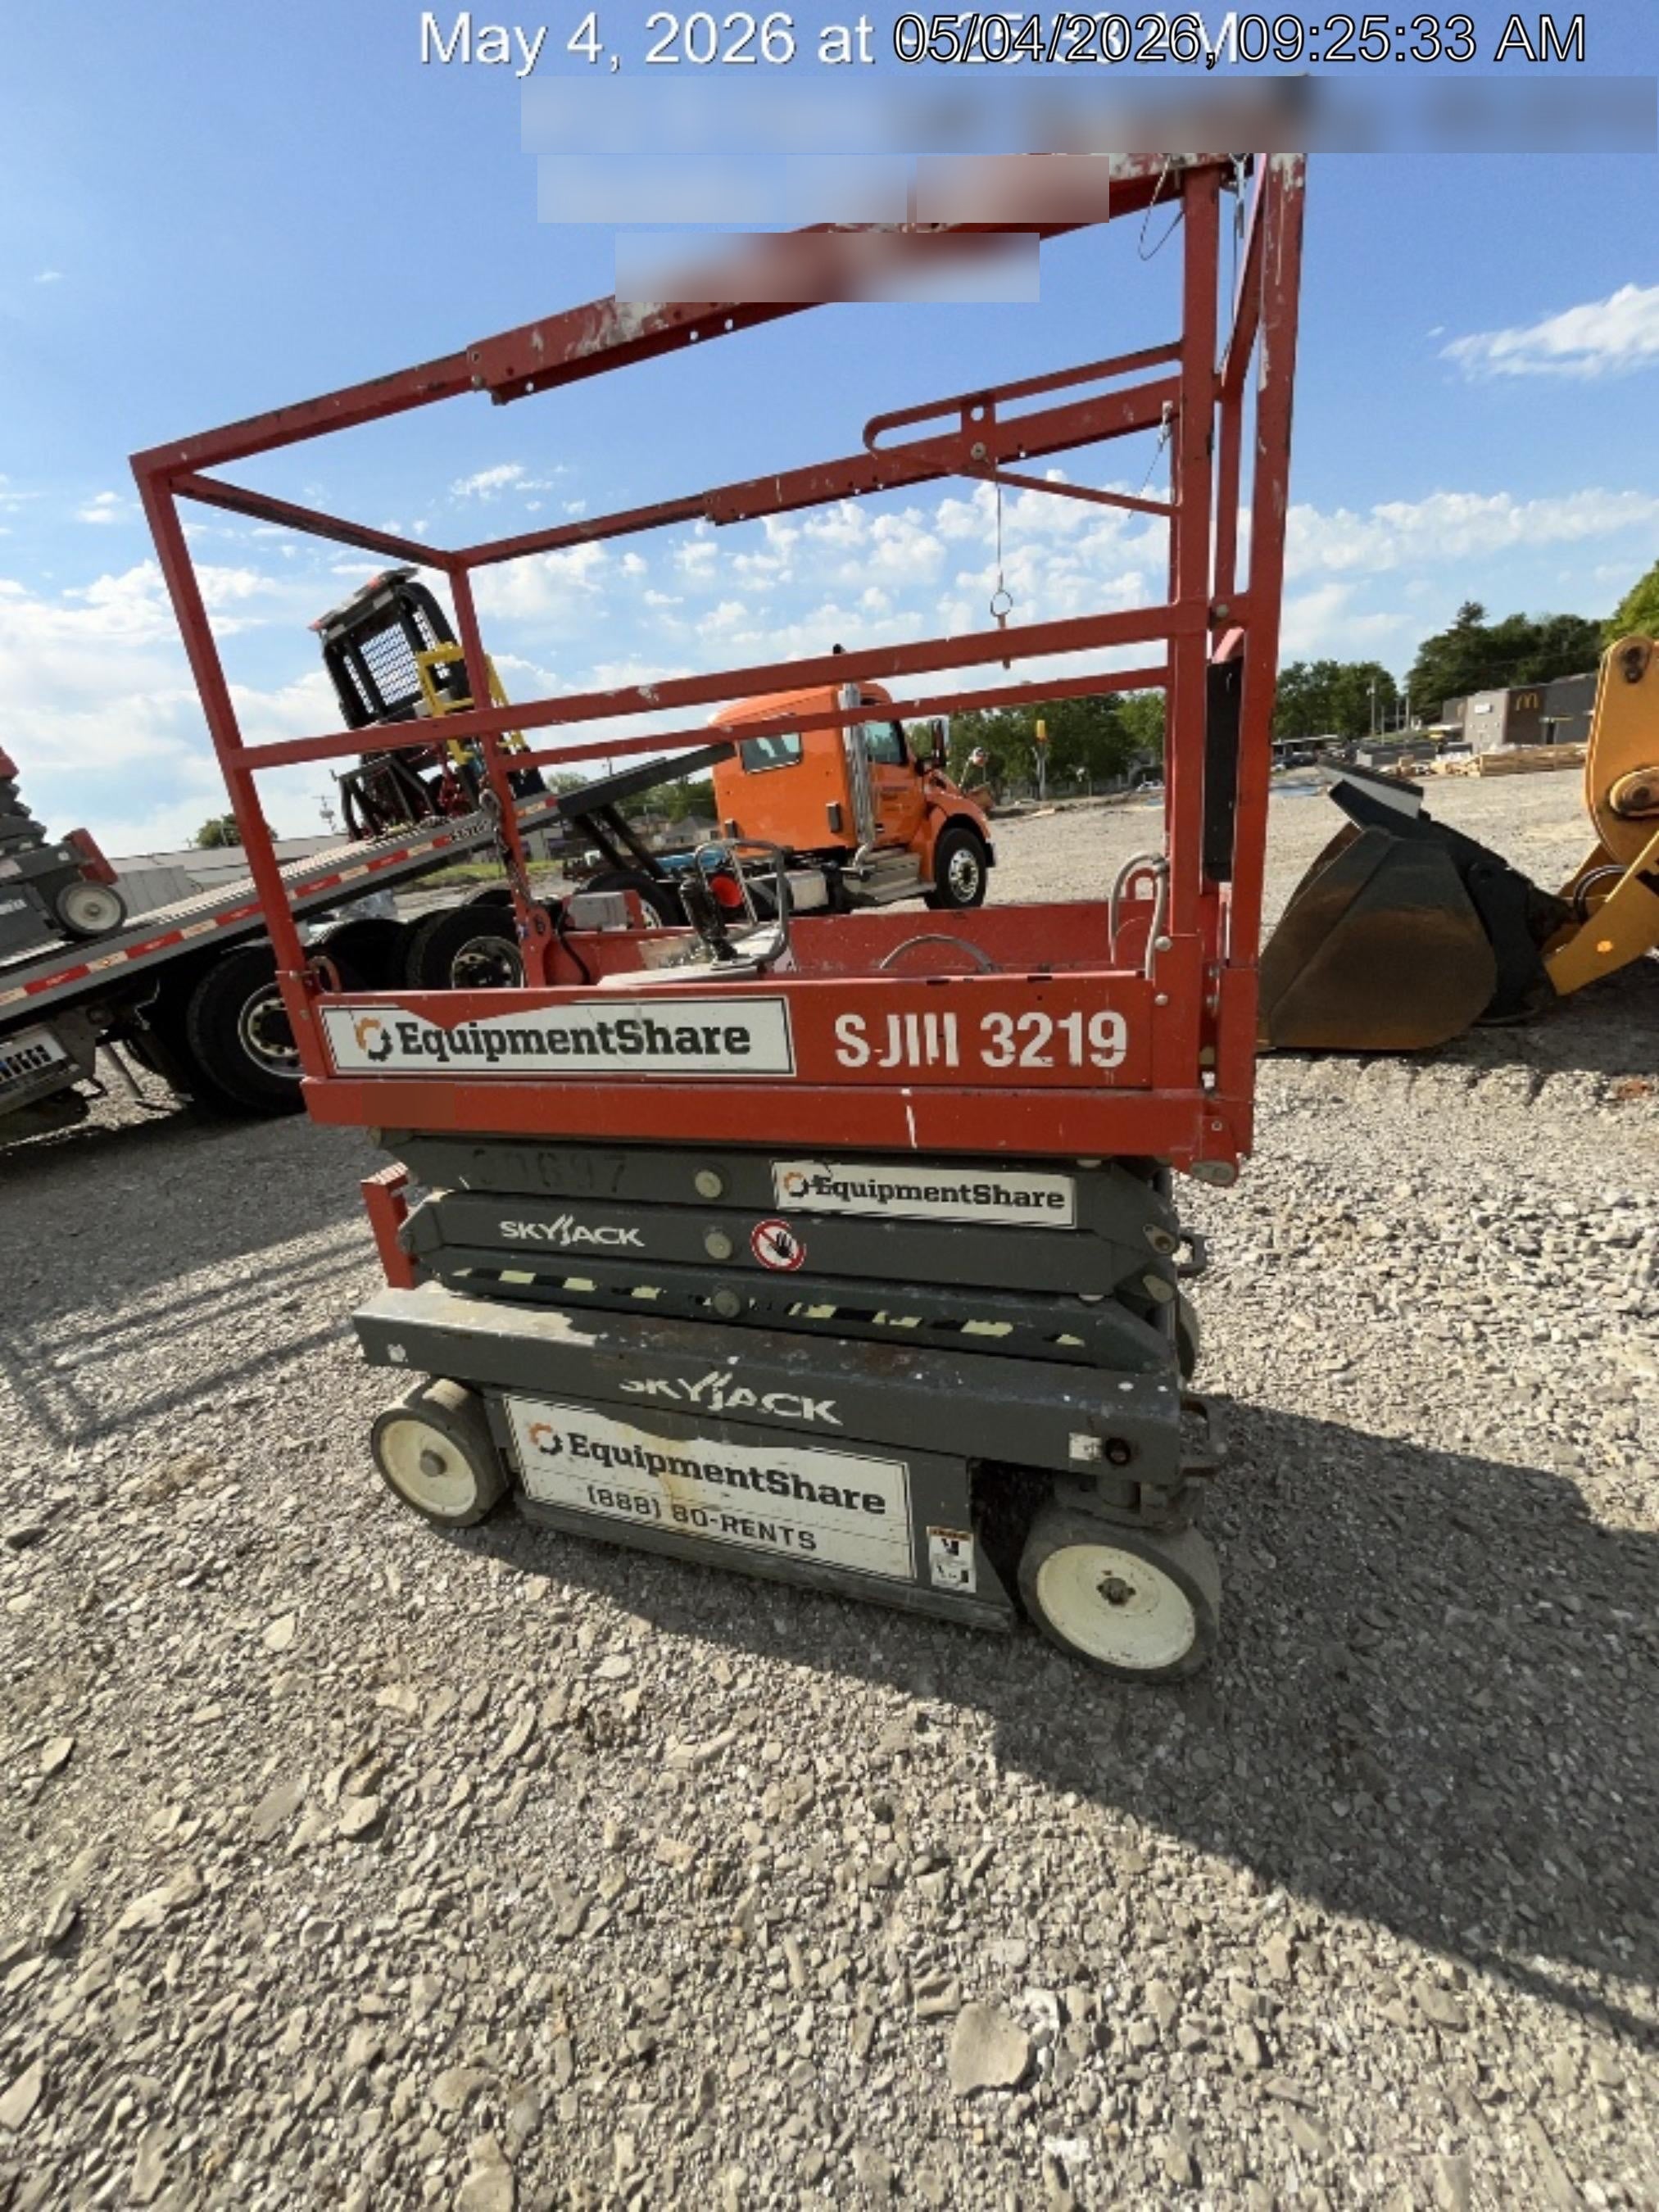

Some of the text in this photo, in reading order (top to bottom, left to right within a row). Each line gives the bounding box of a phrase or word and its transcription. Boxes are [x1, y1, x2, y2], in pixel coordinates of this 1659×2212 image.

[395, 1018, 750, 1063] EquipmentShare
[980, 1011, 1128, 1067] 3219
[810, 1175, 1065, 1209] EquipmentShare
[499, 1213, 646, 1247] SKYJACK
[567, 1431, 886, 1516] EquipmentShare
[587, 1484, 818, 1552] (888) 80-RENTS
